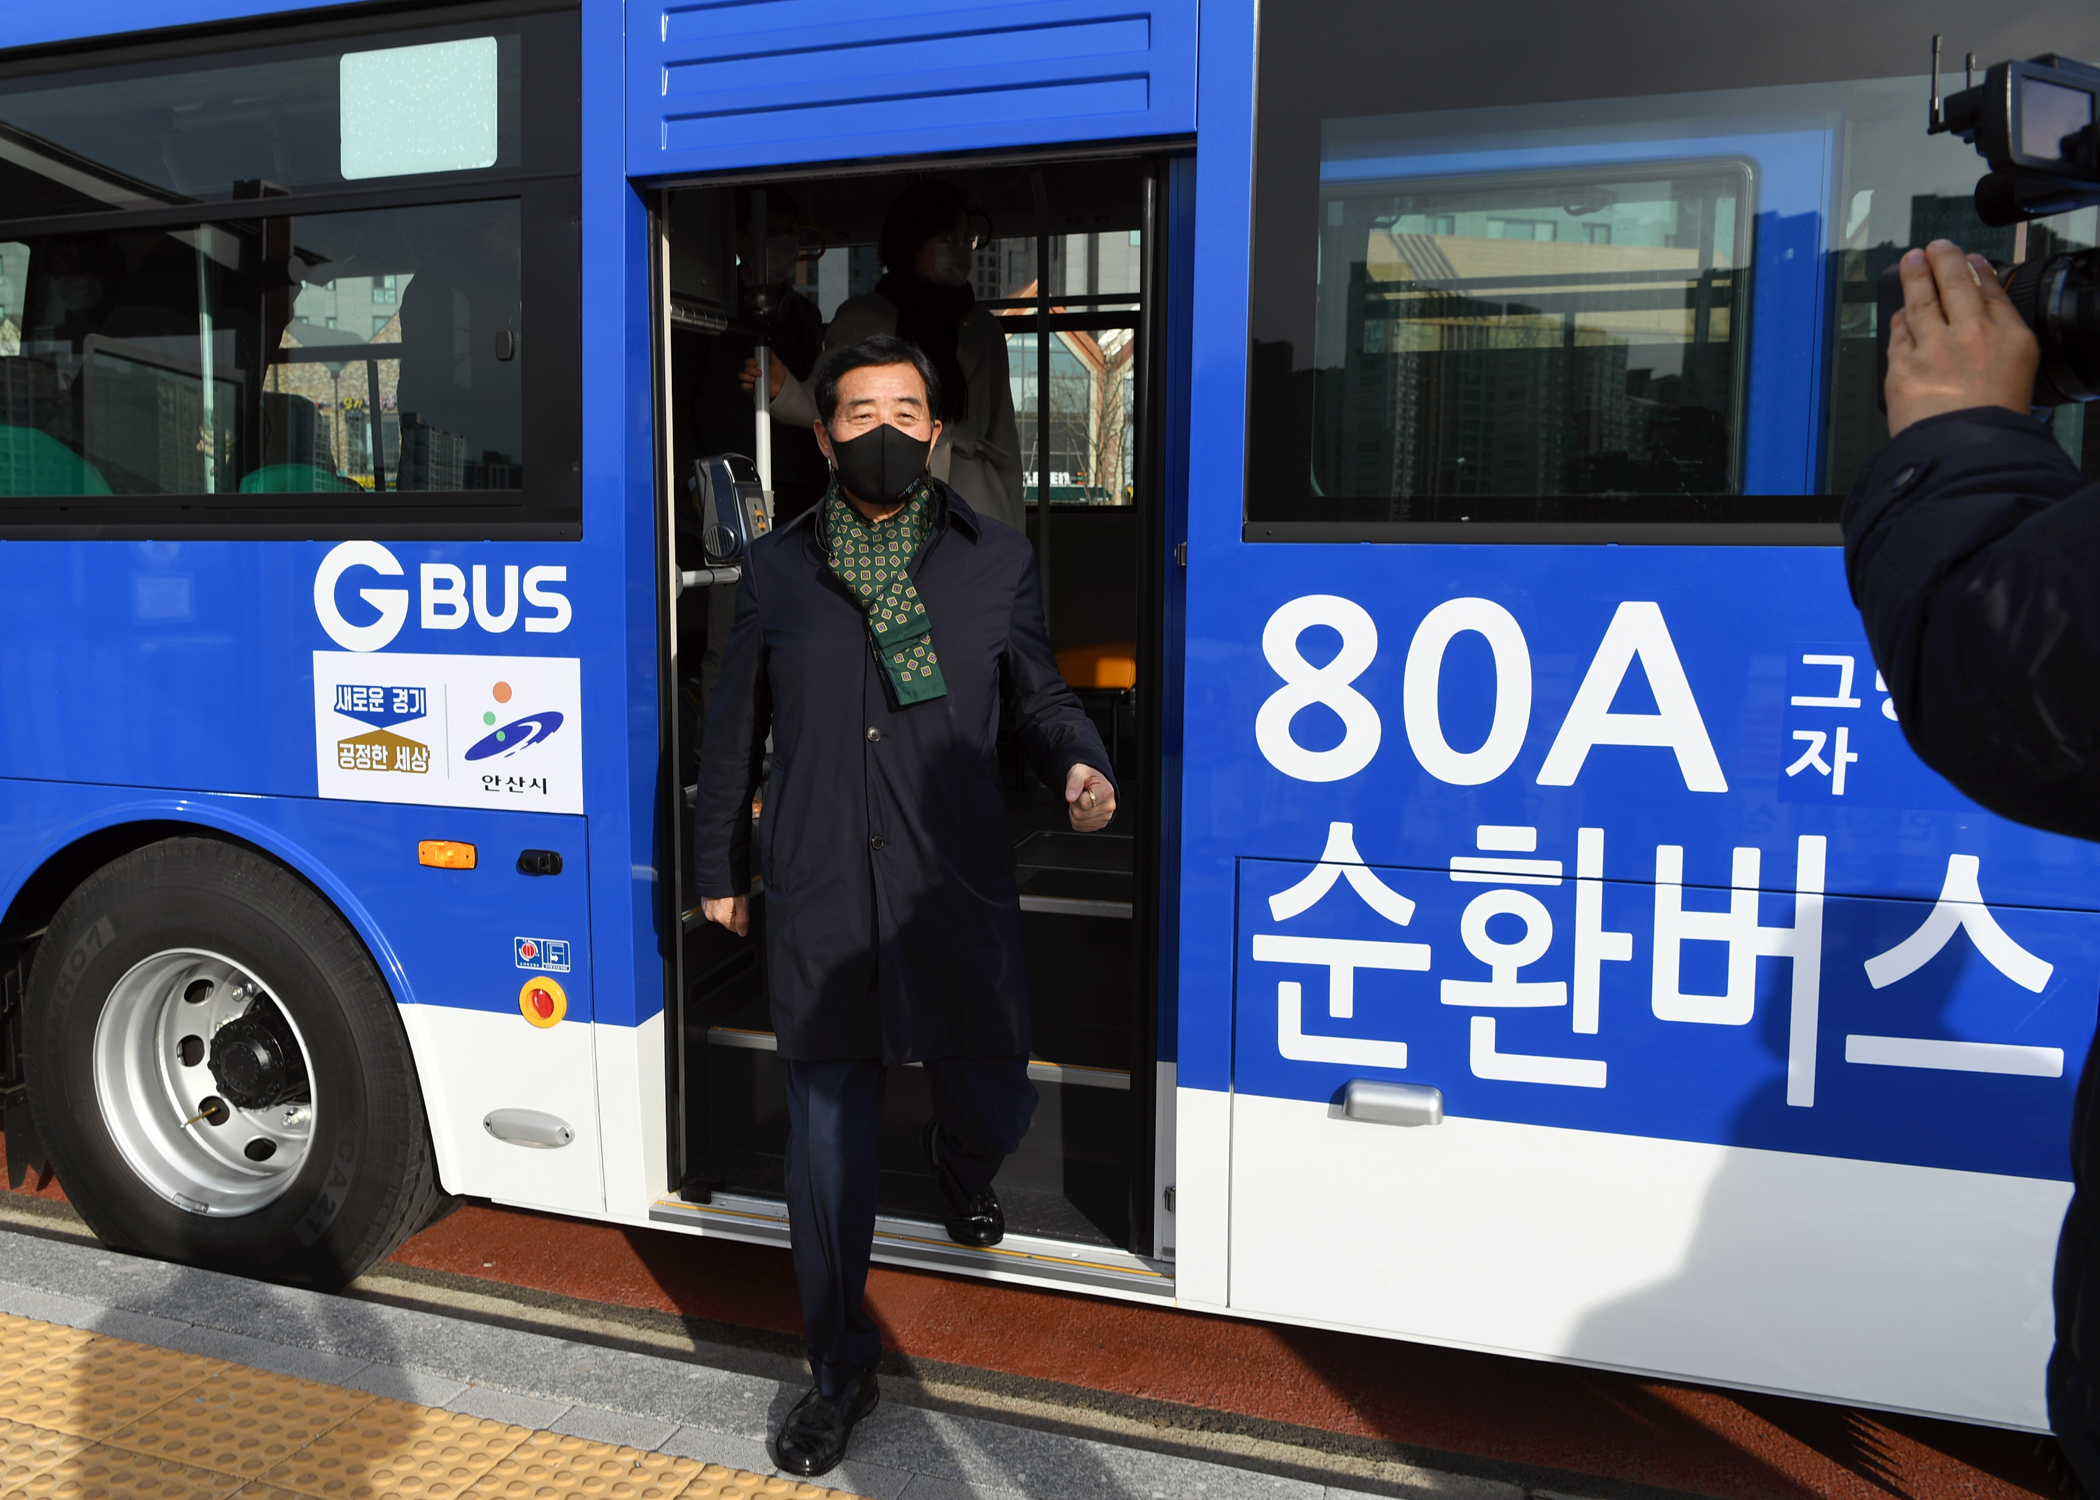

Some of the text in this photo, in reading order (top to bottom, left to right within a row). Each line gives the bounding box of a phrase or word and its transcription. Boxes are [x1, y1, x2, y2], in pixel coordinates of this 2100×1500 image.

[420, 563, 573, 634] BUS
[335, 686, 426, 714] 새로운 경기
[1255, 594, 1729, 793] 80A
[339, 743, 430, 773] 공정한 세상
[481, 774, 548, 795] 안산시
[1252, 821, 2065, 1108] 순환버스
